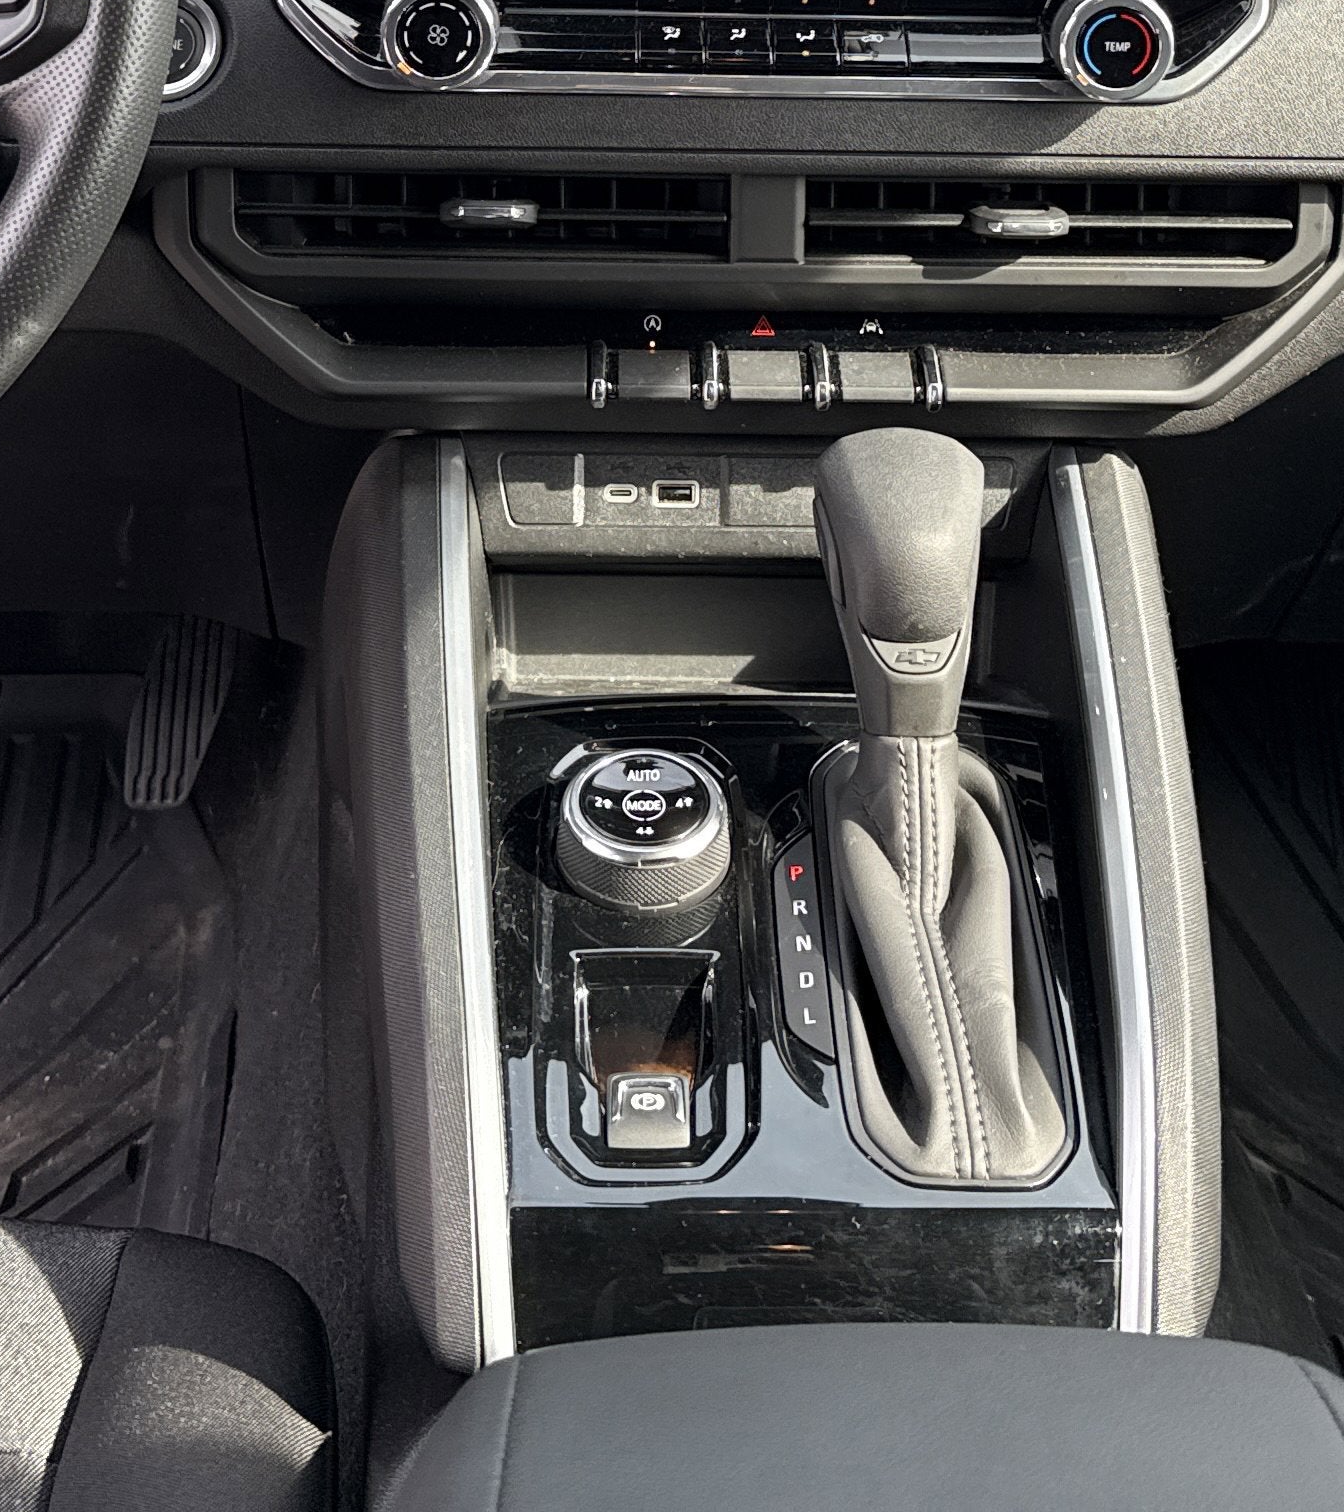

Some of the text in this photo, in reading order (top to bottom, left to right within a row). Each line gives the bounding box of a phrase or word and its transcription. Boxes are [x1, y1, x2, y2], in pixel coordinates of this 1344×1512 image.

[1104, 41, 1131, 52] TEMP
[626, 769, 661, 782] AUTO
[626, 800, 662, 812] MODE
[789, 865, 804, 881] P
[792, 899, 808, 915] R
[795, 935, 812, 952] N
[799, 972, 815, 988] D
[803, 1008, 817, 1025] L
